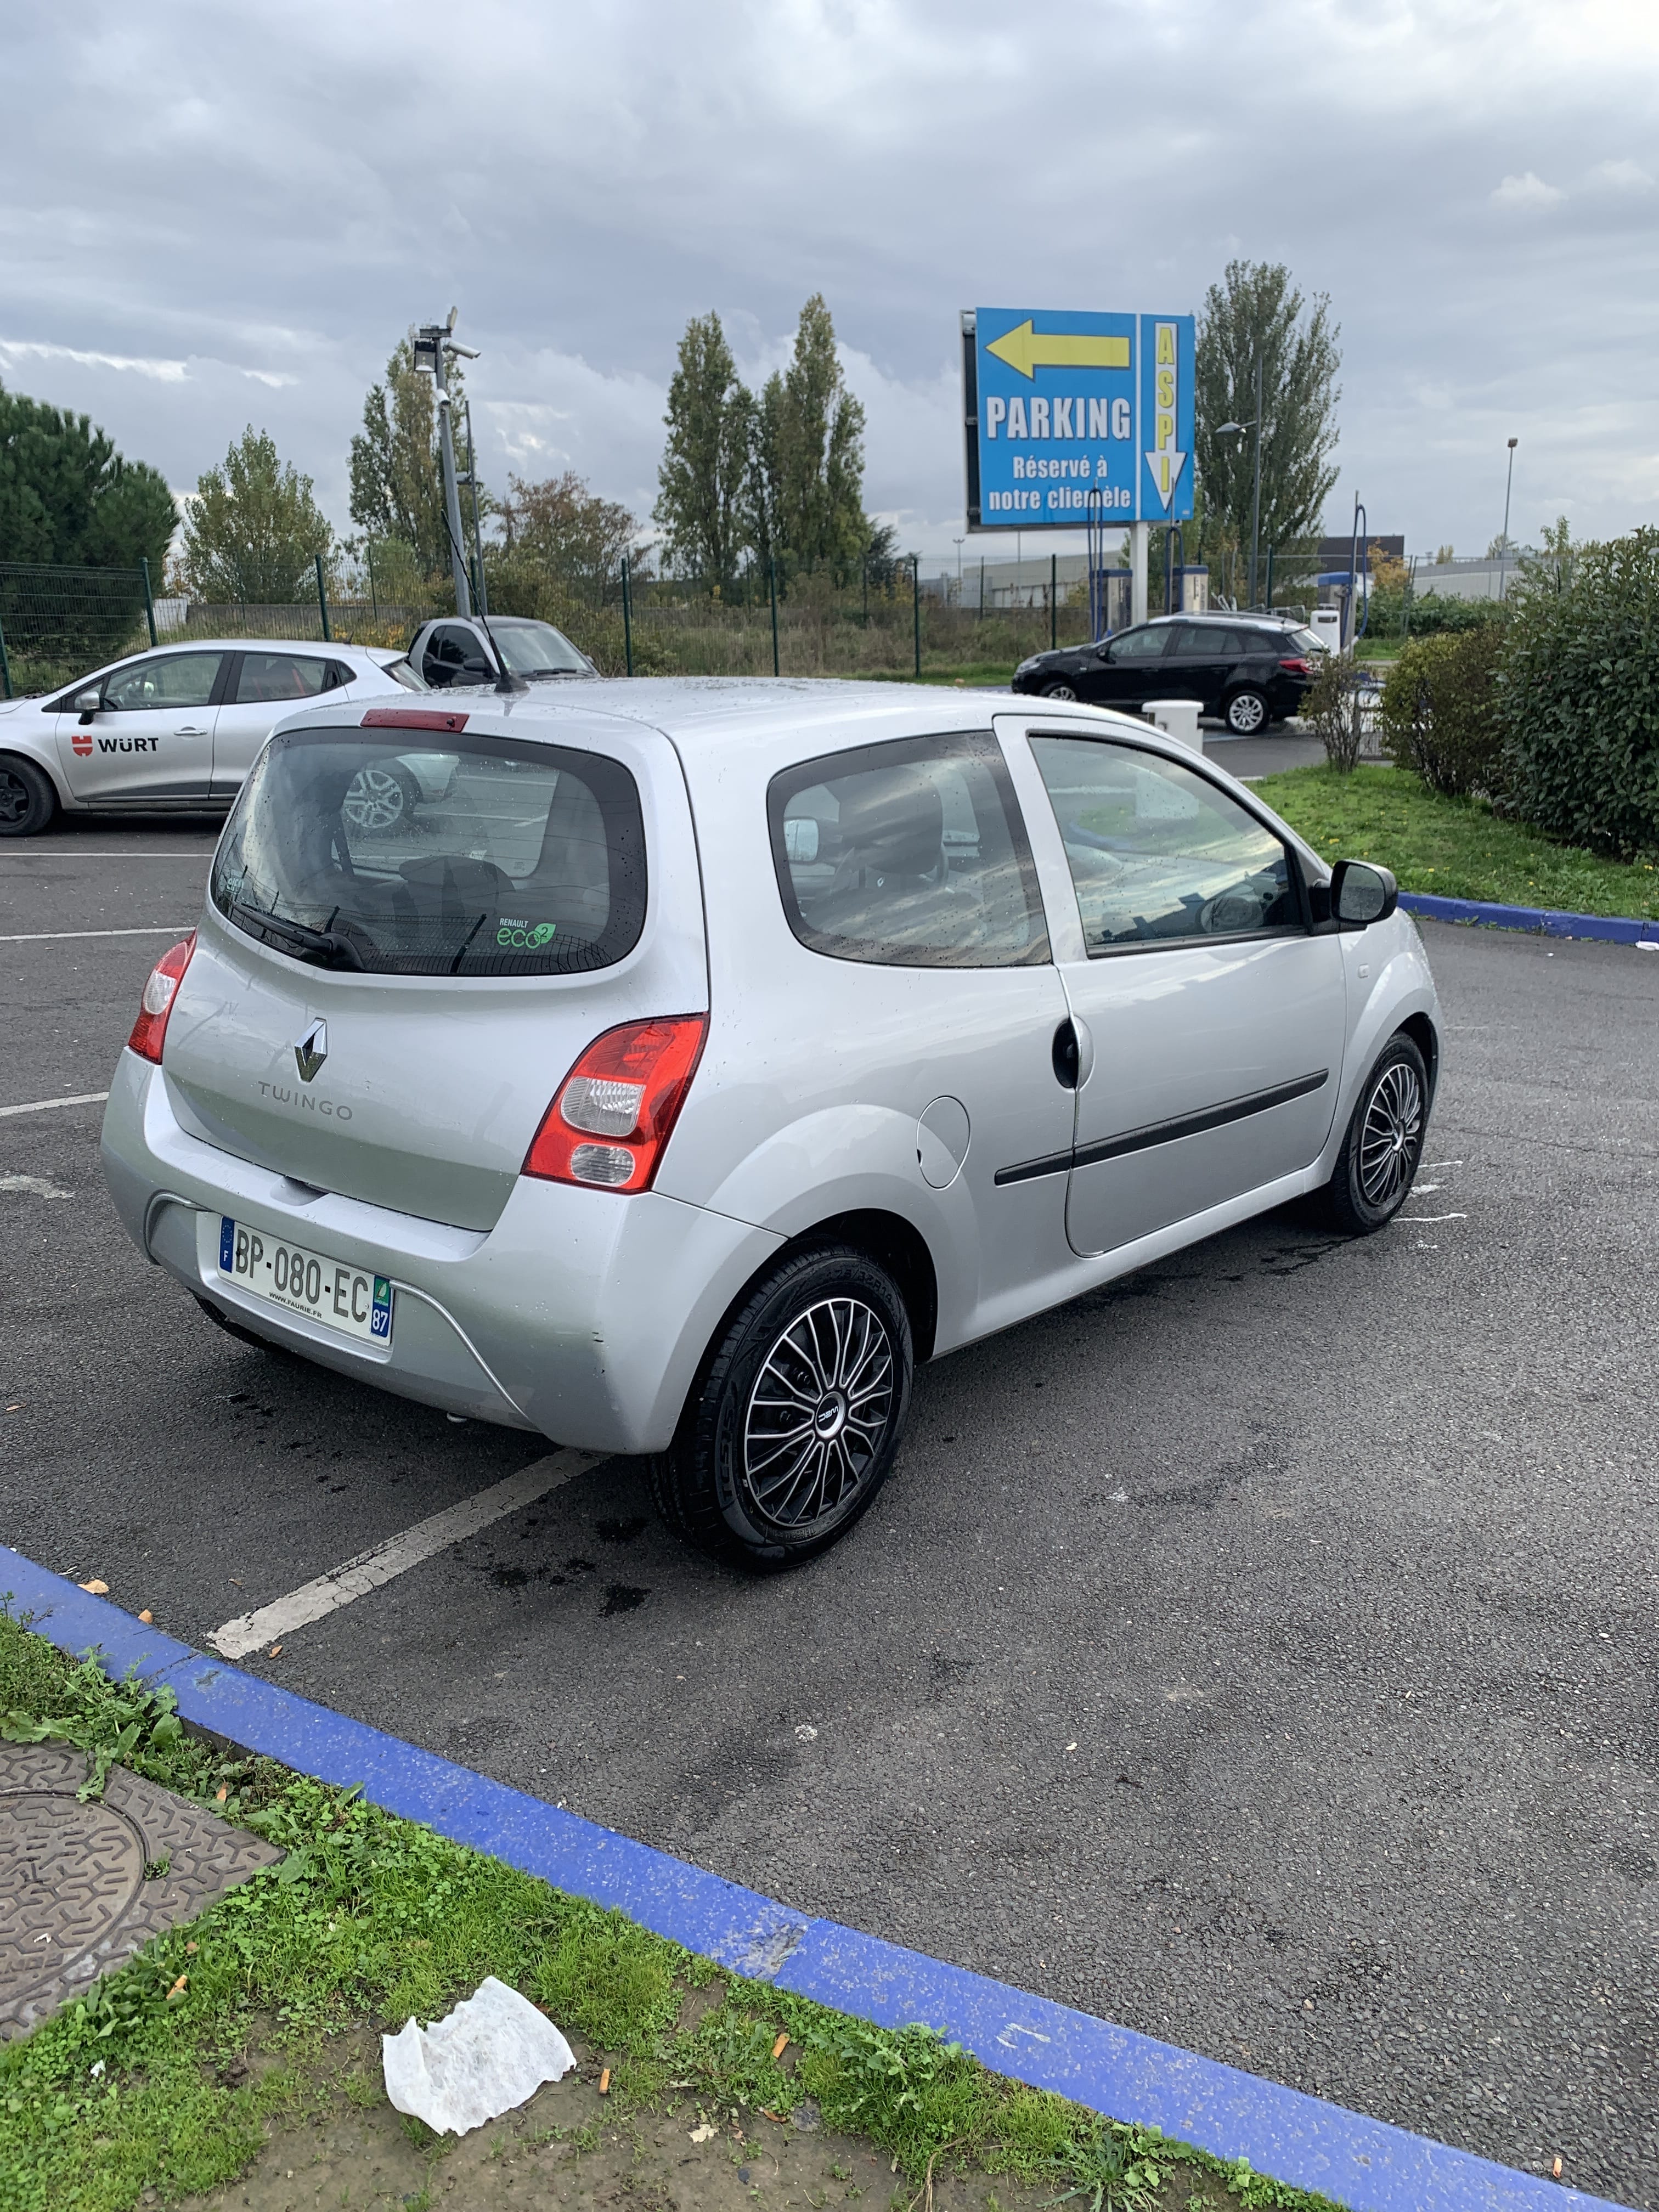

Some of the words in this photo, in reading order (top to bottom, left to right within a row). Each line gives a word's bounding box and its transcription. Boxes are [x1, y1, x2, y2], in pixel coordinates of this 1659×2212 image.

[987, 397, 1131, 439] PARKING
[1013, 455, 1090, 478] Réservé
[1097, 455, 1108, 478] à
[989, 490, 1041, 510] notre
[500, 918, 528, 928] RENAULT
[258, 1081, 353, 1120] TWINGO
[223, 1250, 229, 1262] F
[235, 1229, 368, 1323] BP-080-EC
[269, 1291, 322, 1318] WWW.FAURIE.FR
[373, 1309, 388, 1332] 87
